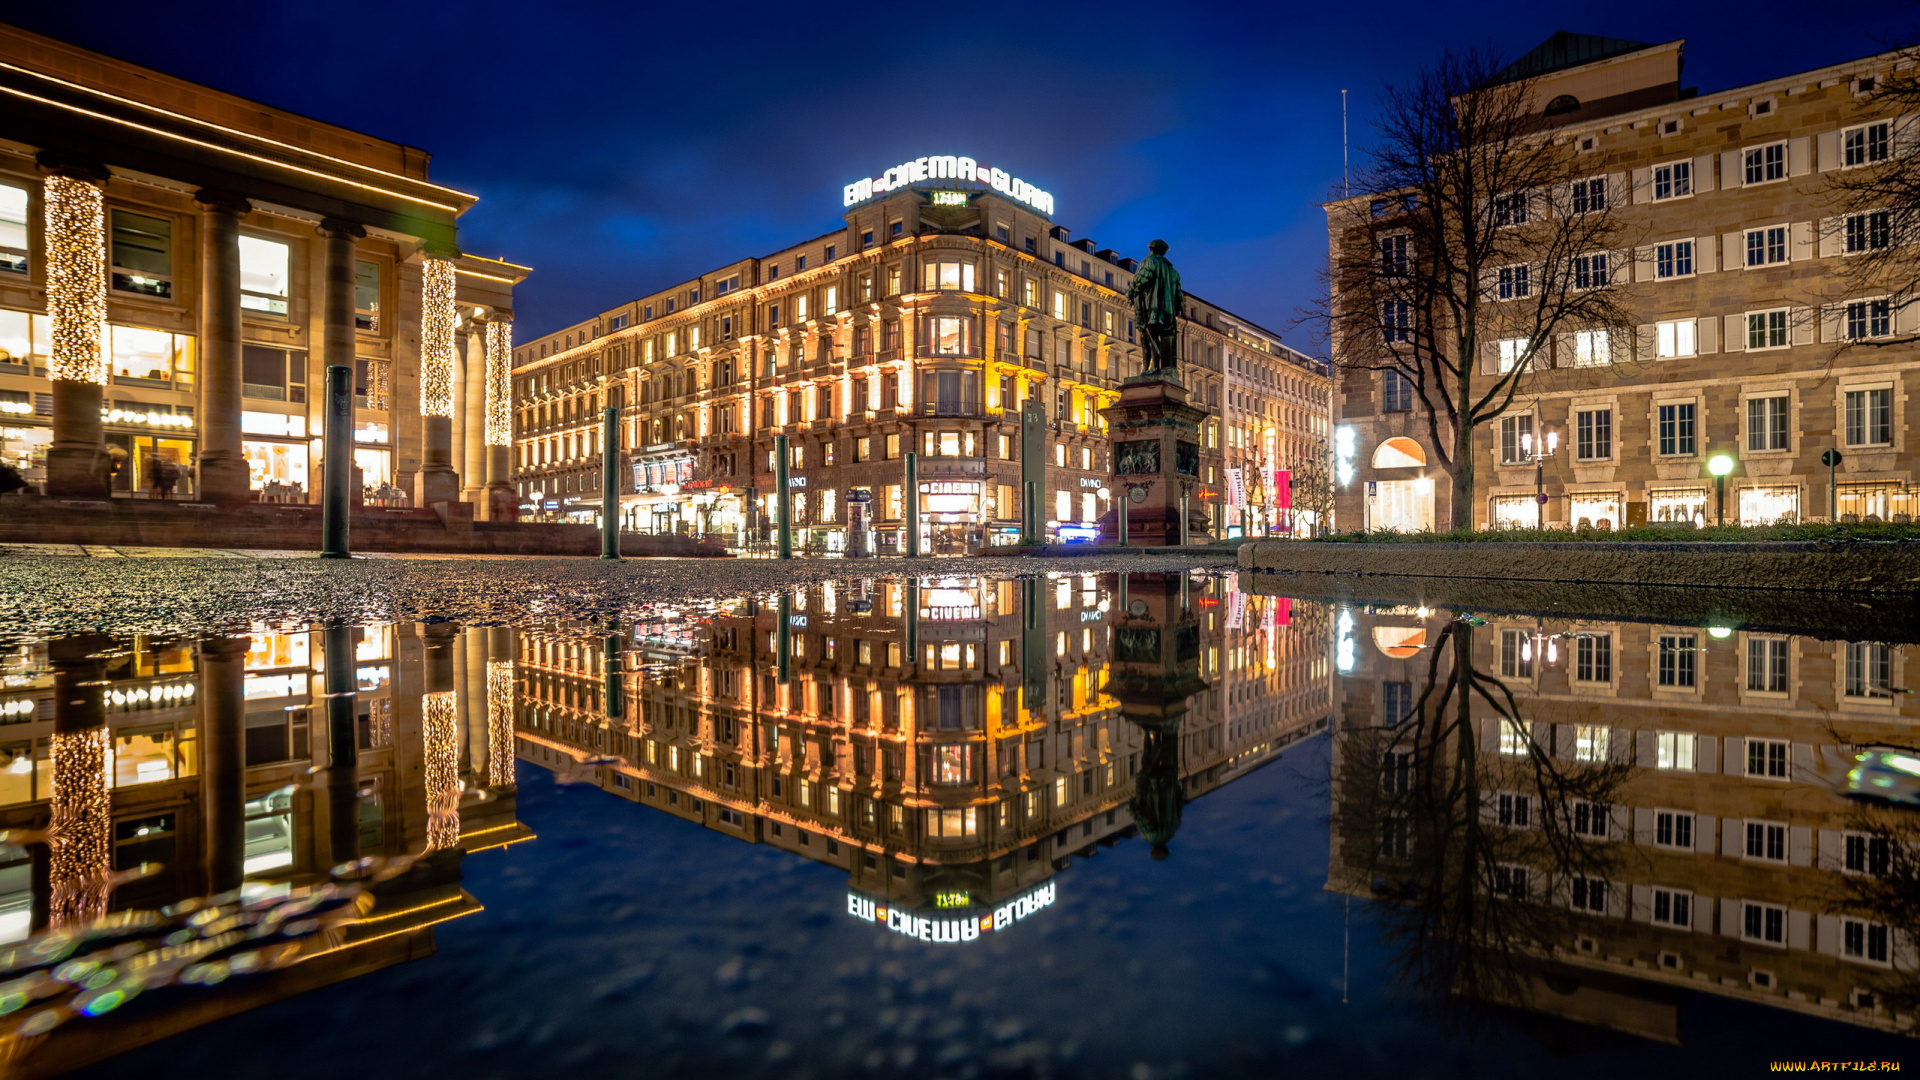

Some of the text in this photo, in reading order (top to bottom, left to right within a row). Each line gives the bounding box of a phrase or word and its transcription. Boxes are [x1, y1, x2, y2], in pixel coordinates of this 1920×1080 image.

[844, 155, 1054, 216] EM CINEMA GLORIA
[930, 482, 980, 494] CINEMA
